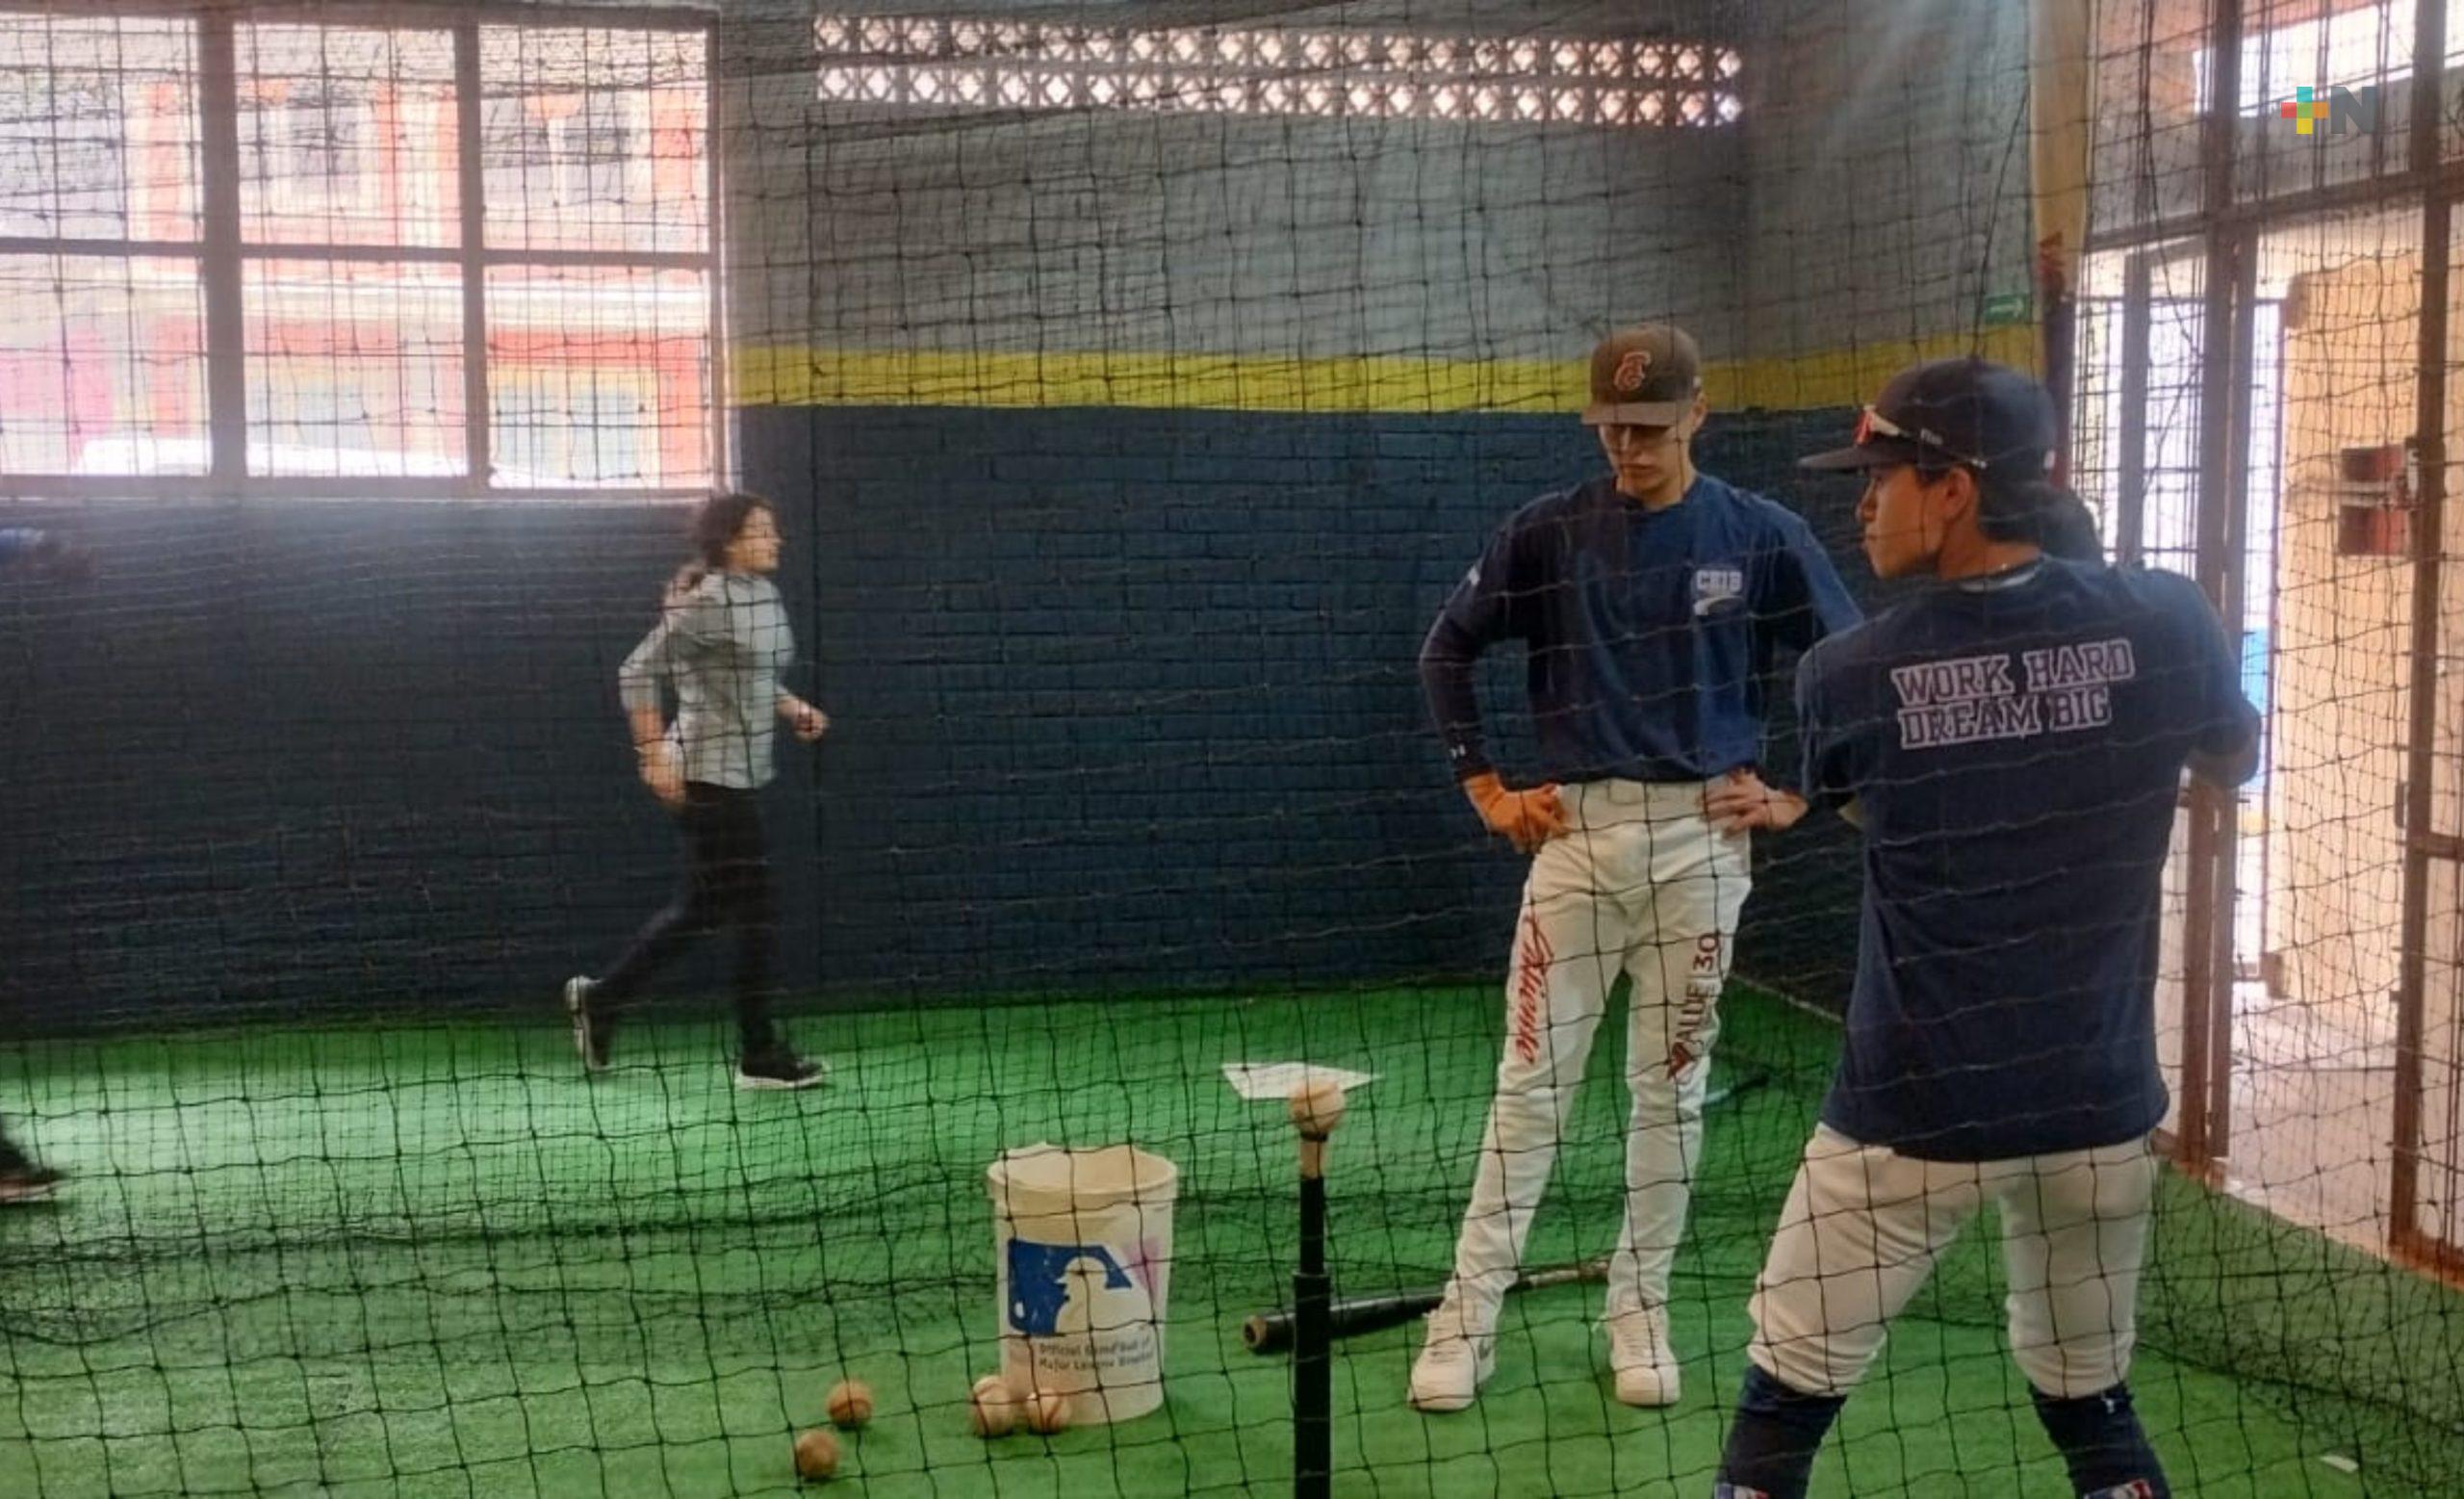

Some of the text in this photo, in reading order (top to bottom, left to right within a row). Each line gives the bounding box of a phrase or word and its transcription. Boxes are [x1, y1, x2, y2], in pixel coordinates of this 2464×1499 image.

[1890, 637, 2135, 706] WORK HARD
[1898, 685, 2113, 749] DREAM BIG
[1693, 932, 1719, 971] 30
